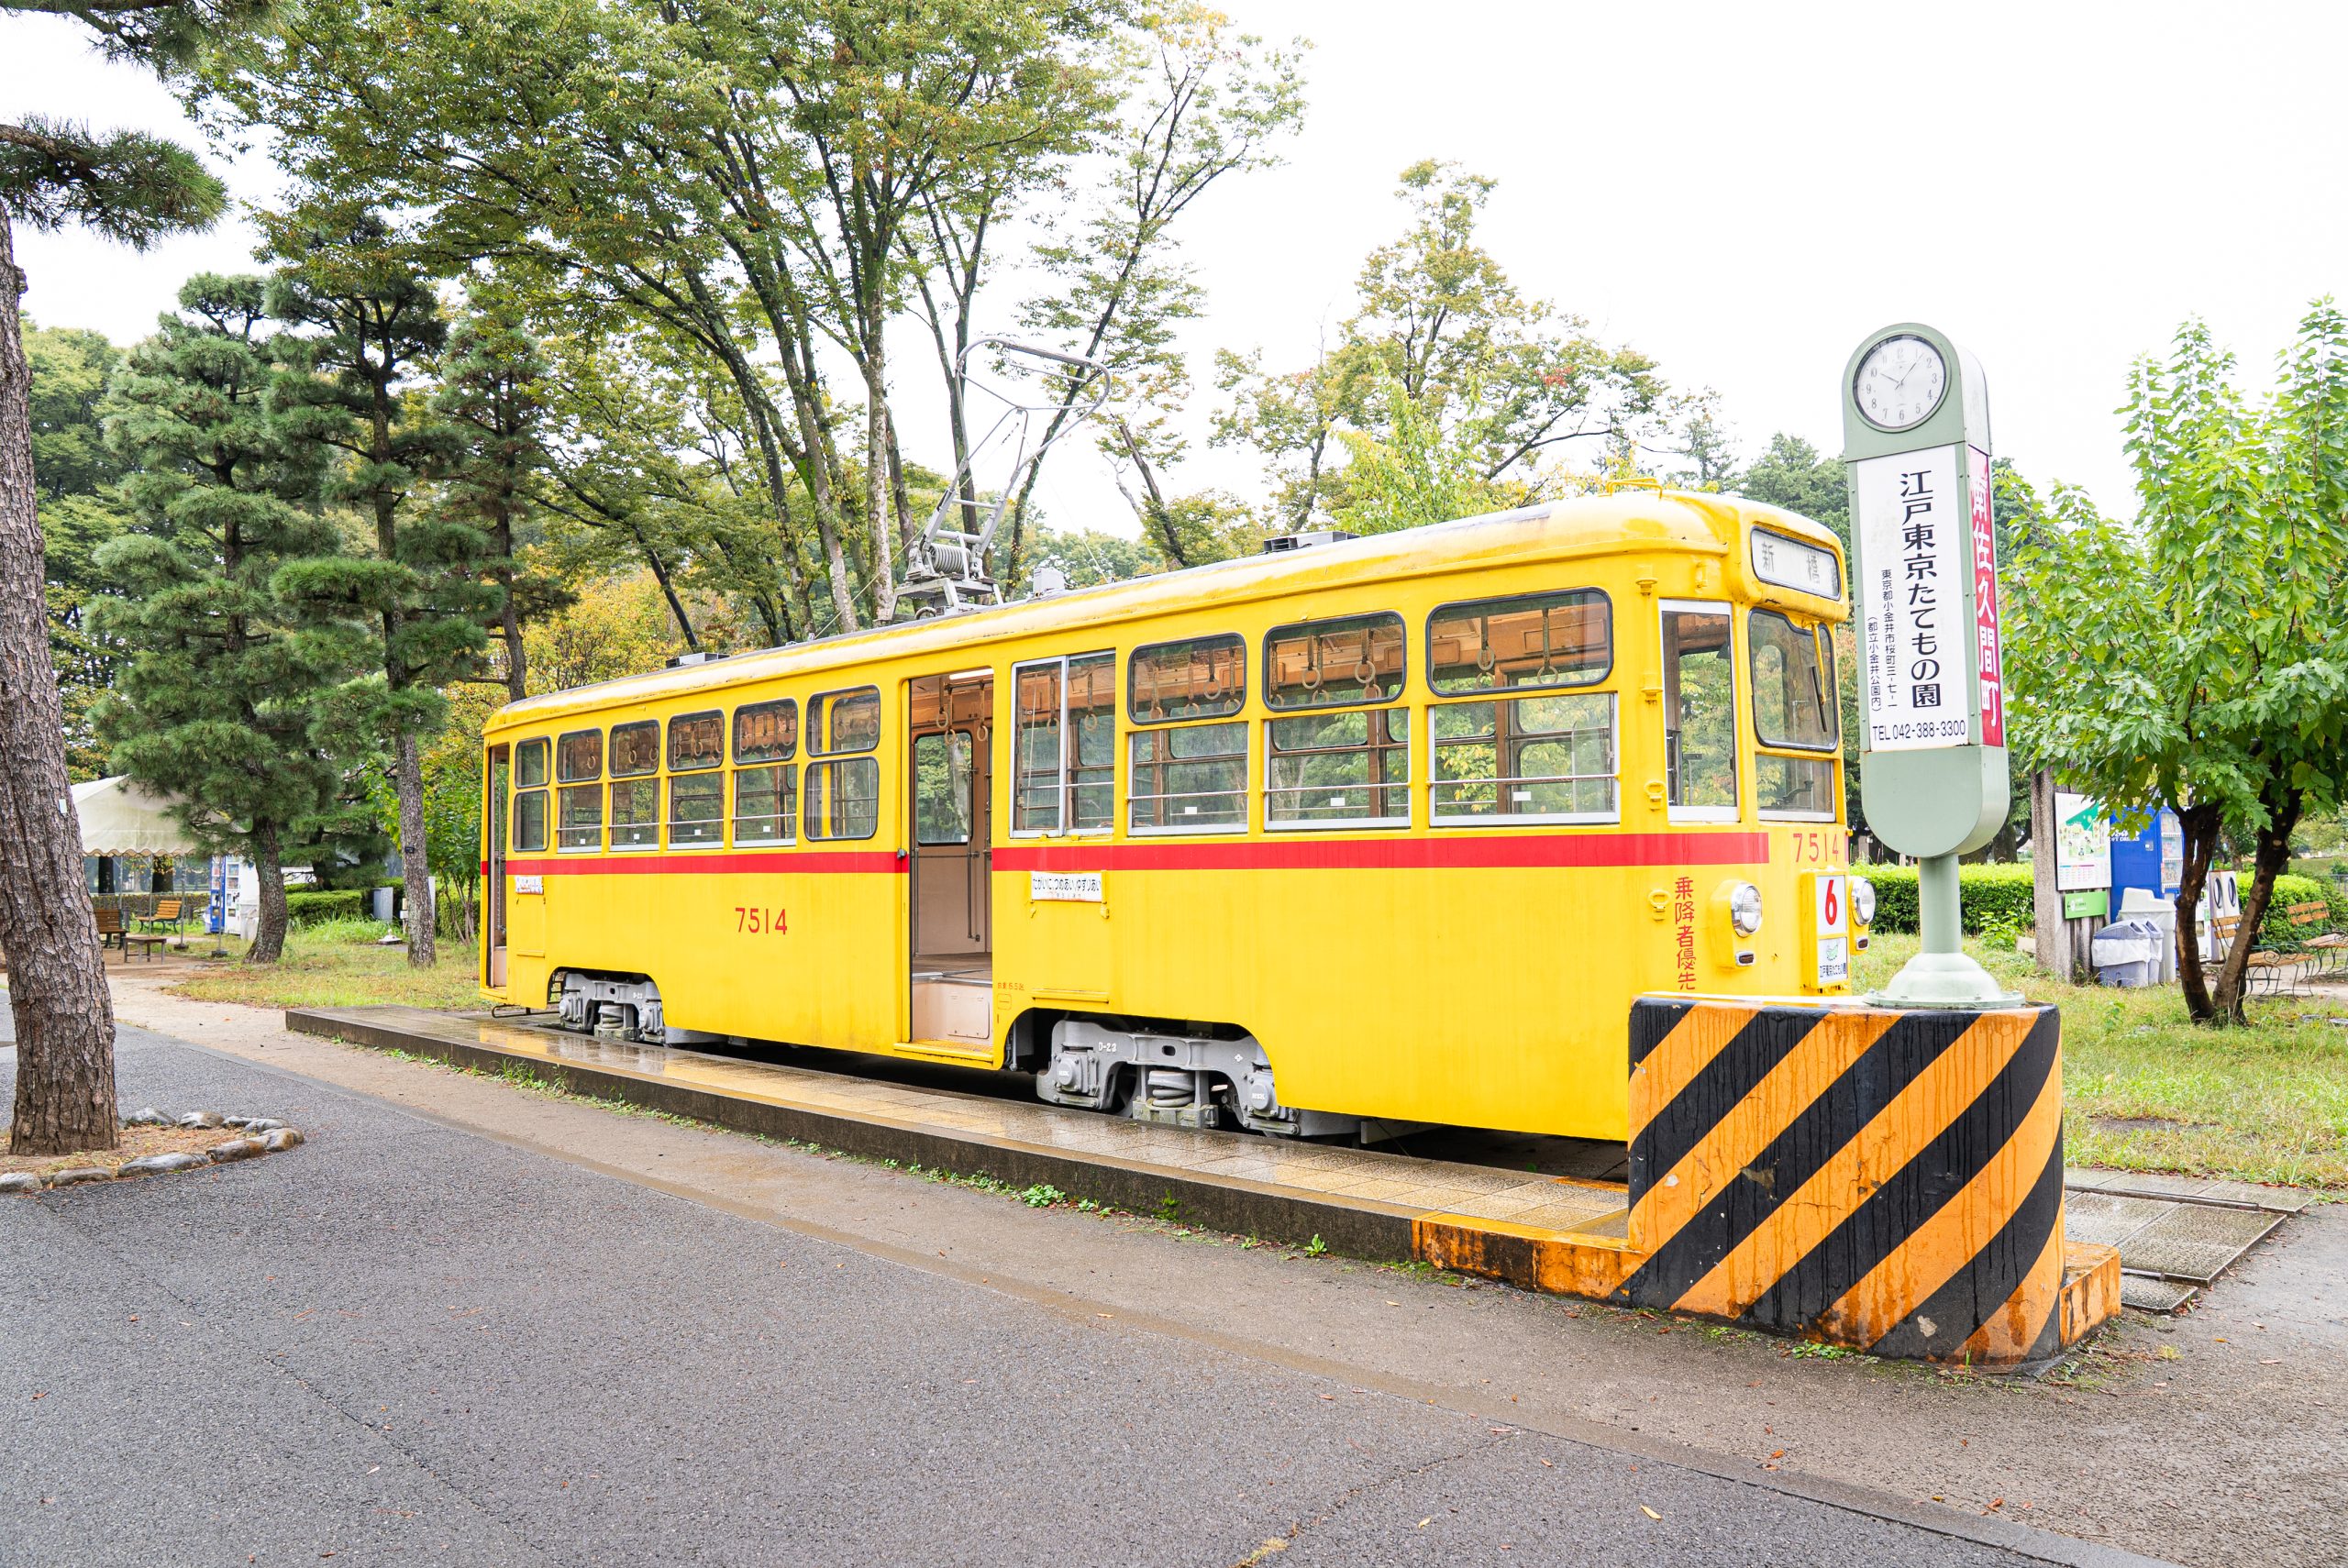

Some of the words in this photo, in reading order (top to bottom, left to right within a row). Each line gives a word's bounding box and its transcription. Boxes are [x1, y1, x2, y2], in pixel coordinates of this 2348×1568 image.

[1899, 469, 1942, 709] 江戸東京たてもの園
[1970, 475, 1999, 727] 南佐久間町
[1872, 724, 1891, 741] TEL
[1892, 719, 1966, 740] 042-388-3300
[1793, 833, 1839, 863] 7514
[735, 906, 788, 935] 7514
[1824, 878, 1838, 926] 6
[1675, 876, 1697, 990] 乗降者優先
